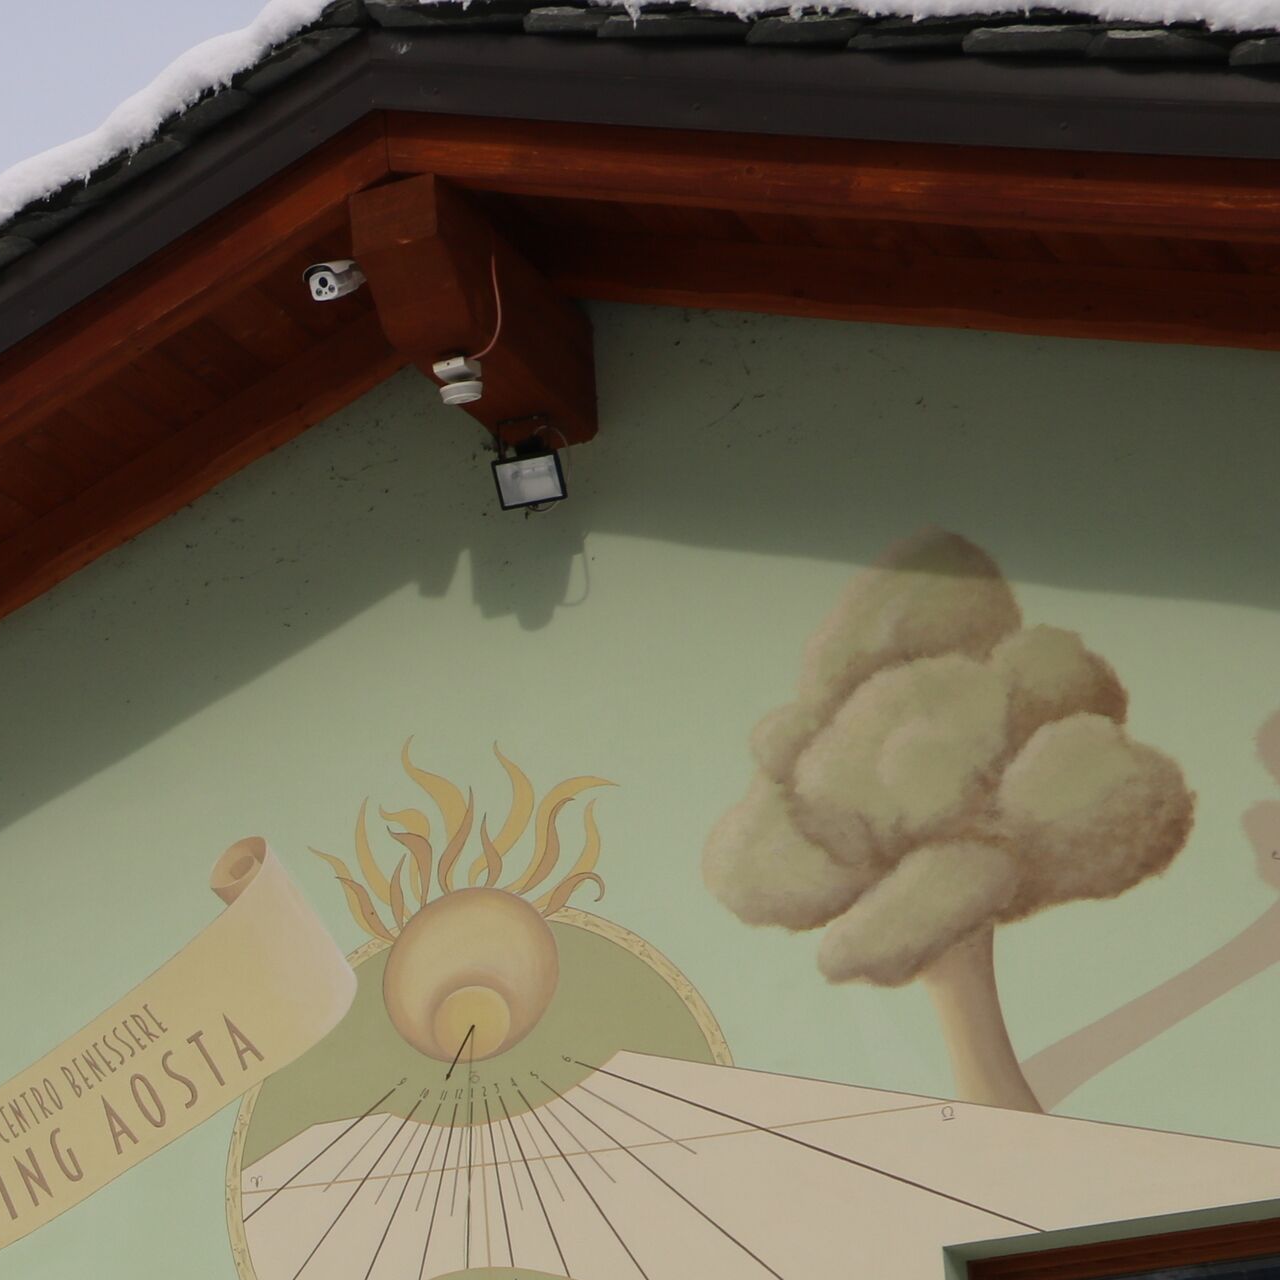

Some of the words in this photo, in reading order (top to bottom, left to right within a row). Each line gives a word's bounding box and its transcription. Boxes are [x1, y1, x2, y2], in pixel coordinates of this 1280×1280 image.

[60, 1003, 169, 1099] BENESSERE
[100, 1012, 265, 1156] AOSTA
[454, 1088, 464, 1099] 12
